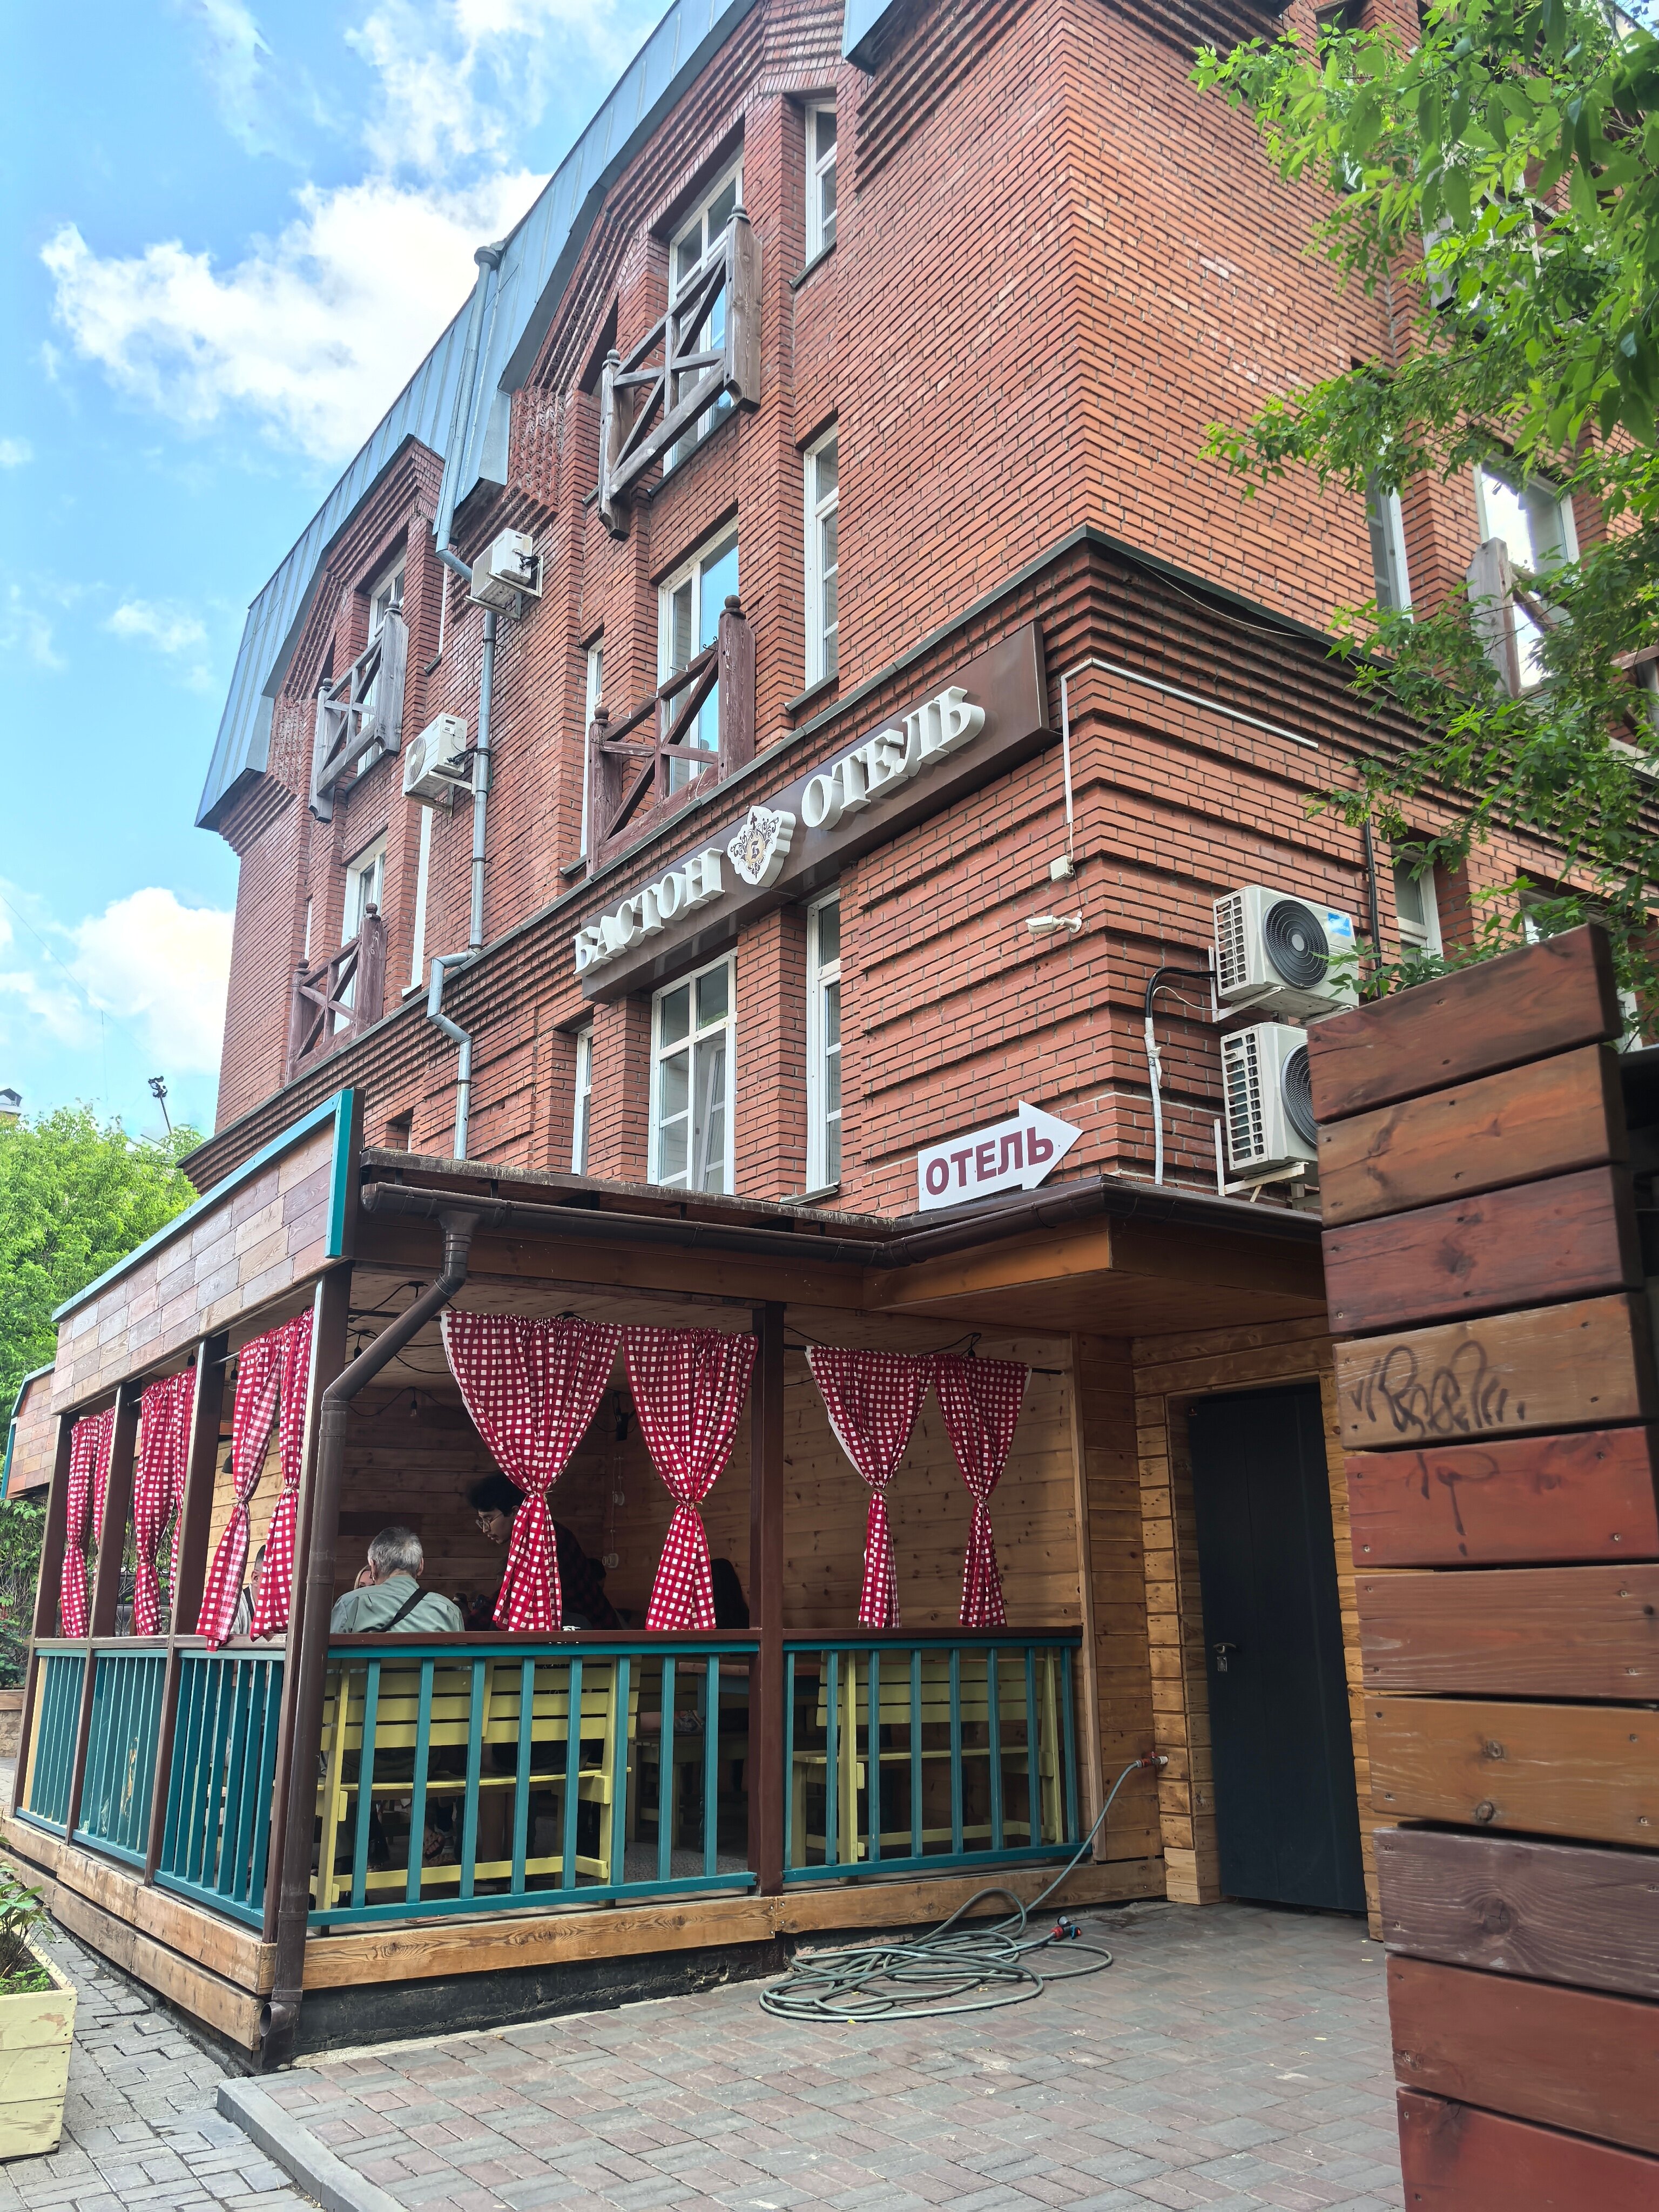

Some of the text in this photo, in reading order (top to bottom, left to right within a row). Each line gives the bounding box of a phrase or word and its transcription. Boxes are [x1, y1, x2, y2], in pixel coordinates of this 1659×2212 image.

[572, 686, 986, 976] БАСТОН ОТЕЛЬ
[926, 1127, 1054, 1196] ОТЕЛЬ
